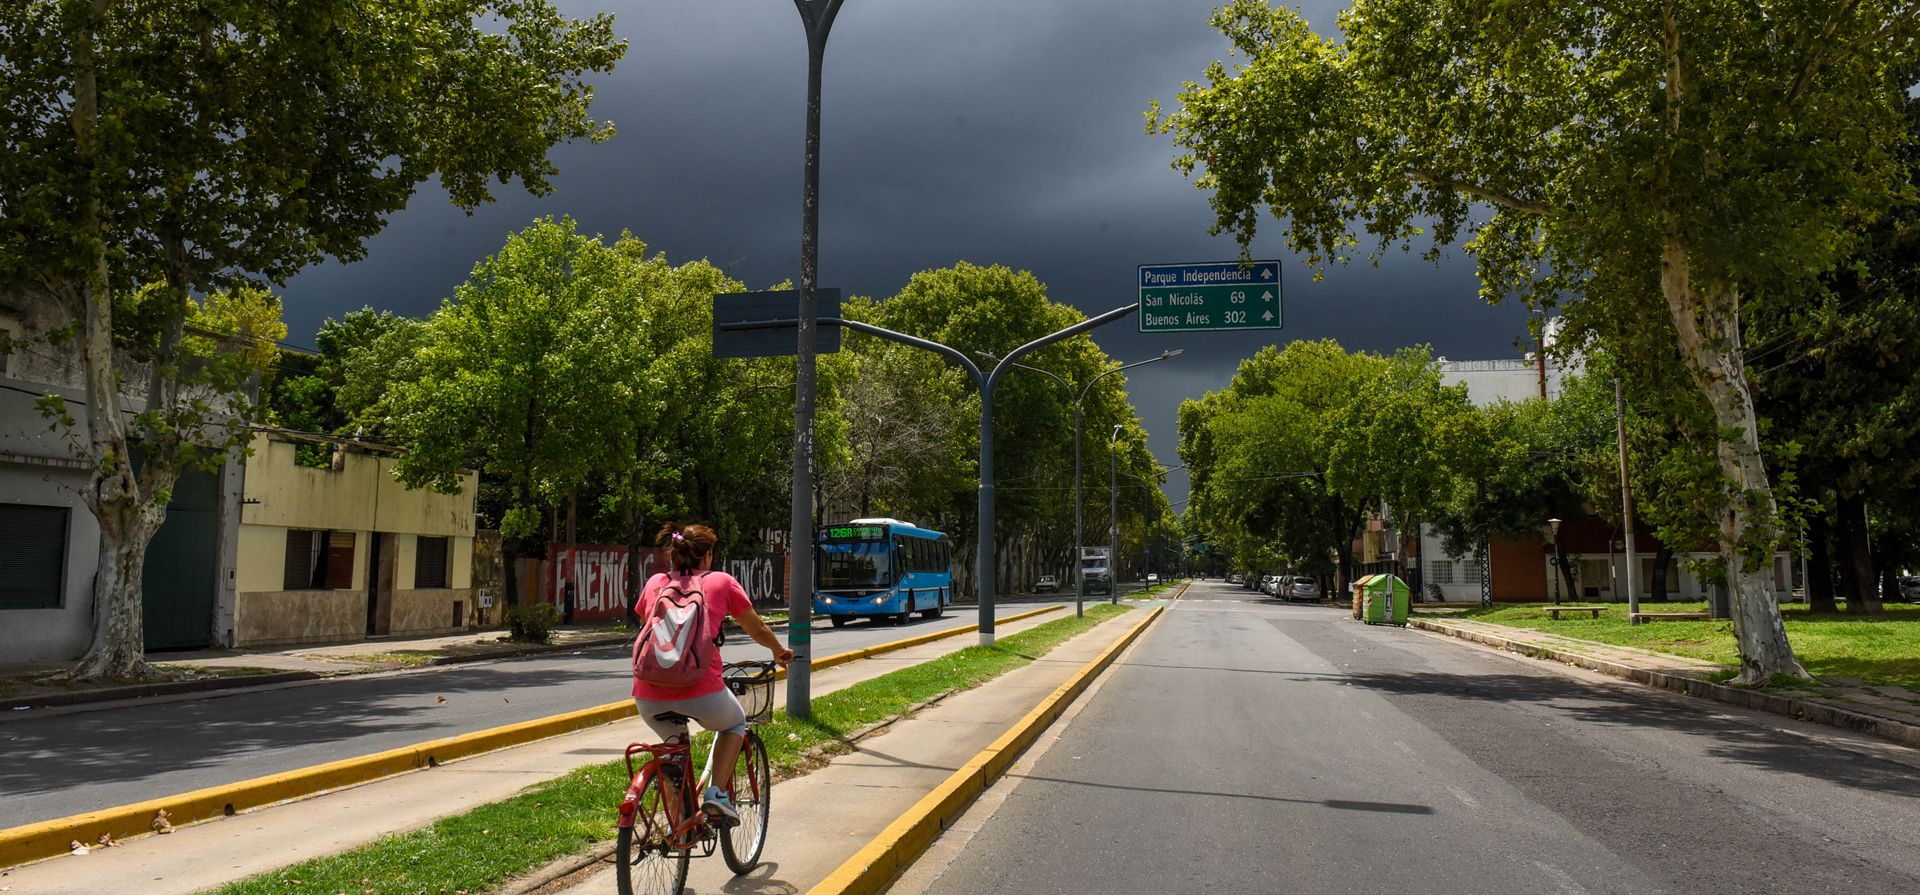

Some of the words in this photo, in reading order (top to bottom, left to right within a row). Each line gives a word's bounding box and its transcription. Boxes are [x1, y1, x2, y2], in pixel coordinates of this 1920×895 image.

[1145, 271, 1177, 285] Parque
[1183, 269, 1251, 284] Independencia
[1145, 294, 1163, 307] San
[1169, 292, 1204, 305] Nicolás
[1230, 291, 1246, 304] 69
[1145, 313, 1179, 326] Buenos
[1186, 312, 1210, 325] Aires
[1224, 310, 1246, 324] 302
